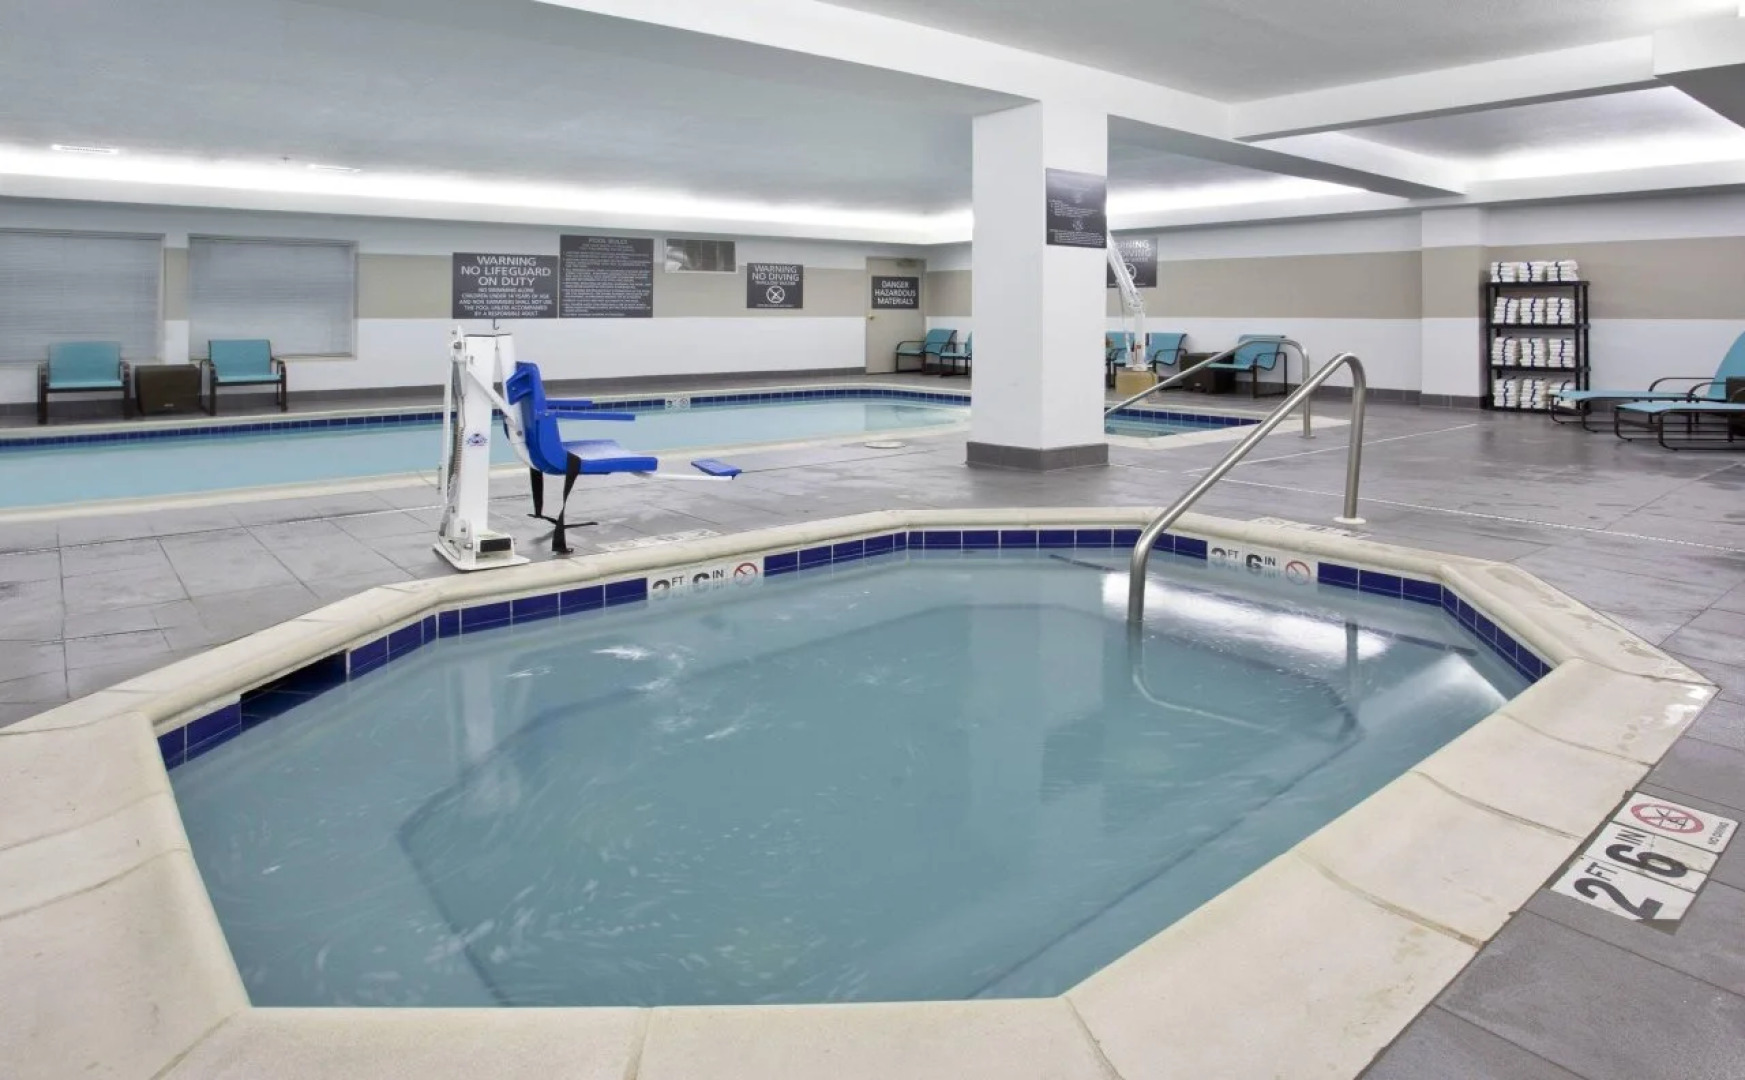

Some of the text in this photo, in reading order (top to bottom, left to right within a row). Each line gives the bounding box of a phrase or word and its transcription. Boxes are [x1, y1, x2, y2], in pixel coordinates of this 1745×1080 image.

[476, 256, 536, 266] WARNING
[461, 266, 551, 276] NO LIFEGUARD
[754, 264, 796, 273] WARNING
[478, 277, 535, 286] ON DUTY
[769, 273, 799, 281] DIVING
[1228, 549, 1238, 559] FT
[1264, 556, 1276, 566] IN
[672, 575, 684, 586] FT
[713, 569, 724, 578] IN
[1574, 829, 1688, 920] 2 FT 6 IN
